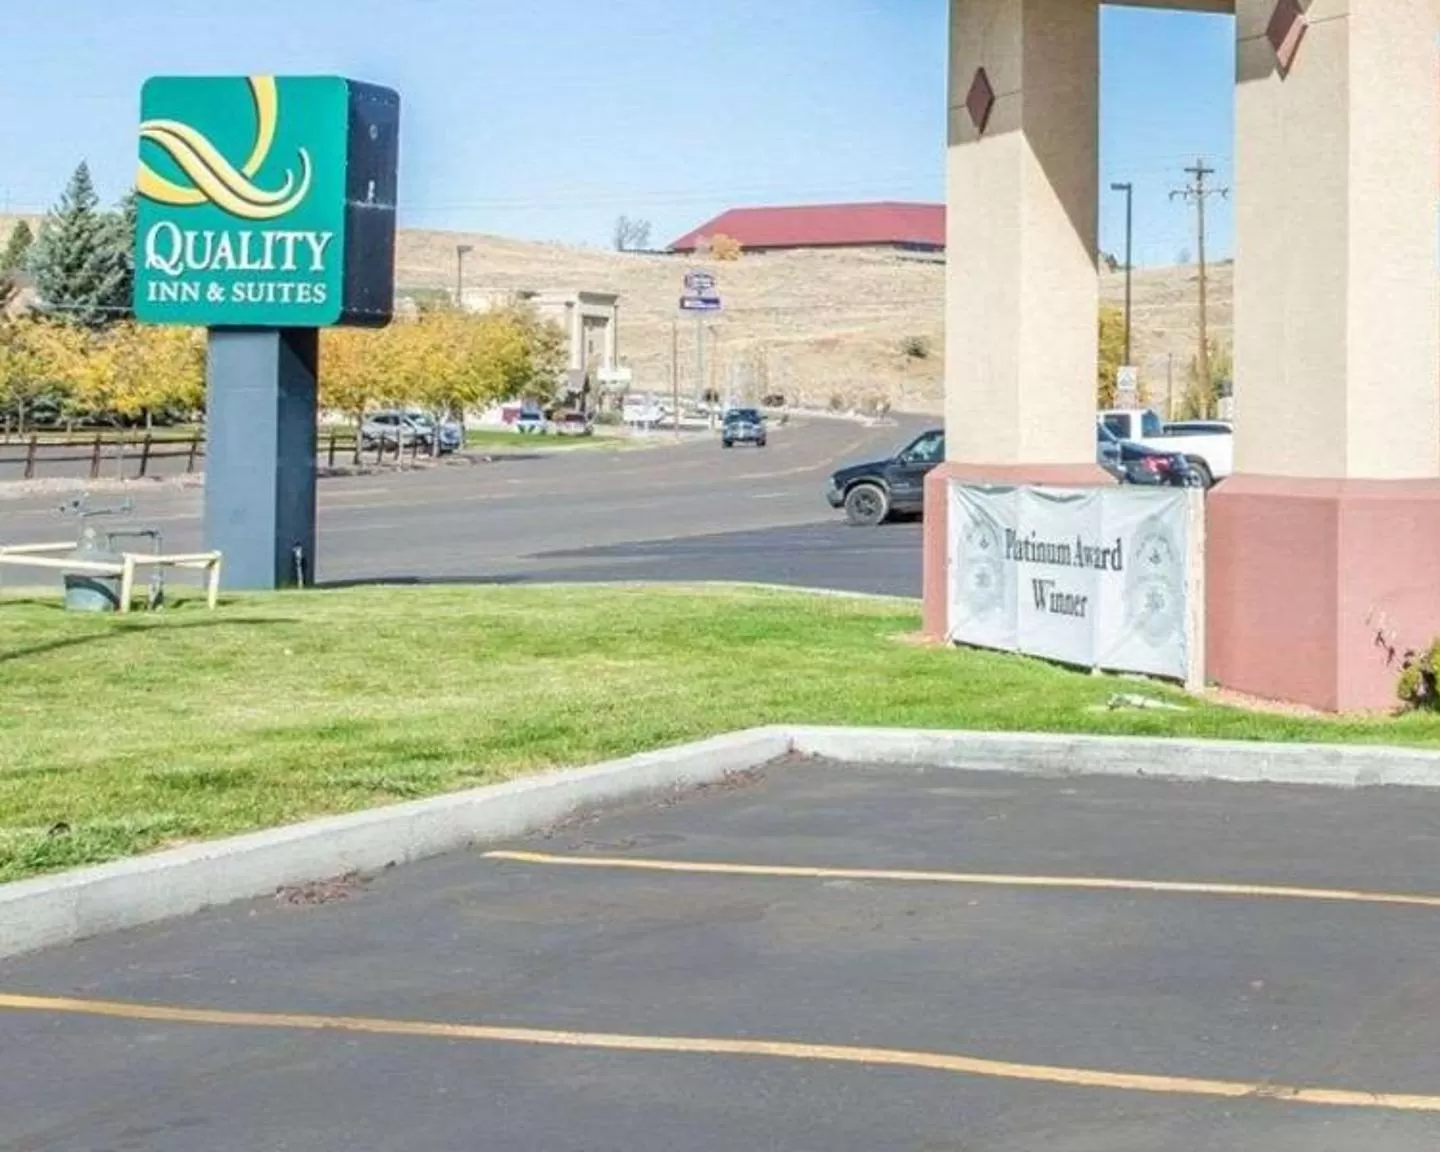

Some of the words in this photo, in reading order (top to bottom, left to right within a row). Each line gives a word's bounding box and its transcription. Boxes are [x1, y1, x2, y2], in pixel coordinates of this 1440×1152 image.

[145, 221, 332, 275] QUALITY
[148, 281, 201, 302] INN
[206, 282, 225, 302] &
[231, 282, 326, 303] SUITES
[1005, 528, 1072, 566] Platinum
[1074, 535, 1122, 571] Award
[1032, 579, 1087, 617] Winner
